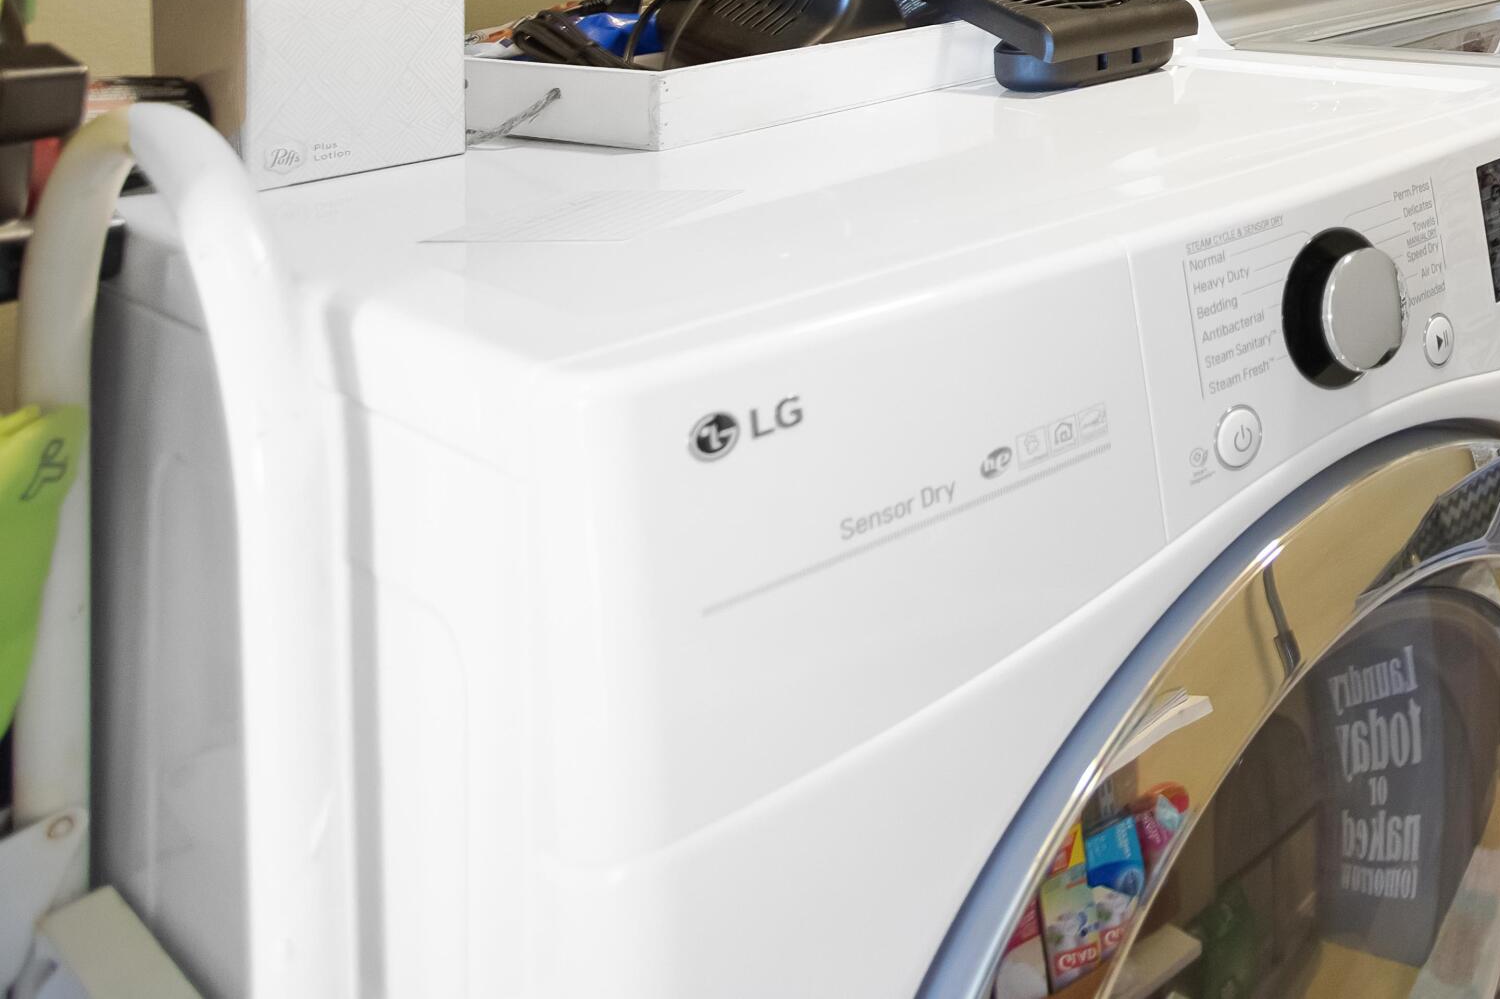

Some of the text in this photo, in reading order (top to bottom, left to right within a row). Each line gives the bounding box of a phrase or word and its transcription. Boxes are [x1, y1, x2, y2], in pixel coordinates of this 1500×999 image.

[313, 150, 351, 162] Lotion
[314, 142, 338, 151] Plus
[270, 148, 301, 169] Puffs
[1403, 200, 1433, 218] Delicates
[1412, 217, 1436, 233] Towels
[1189, 250, 1226, 272] Normal
[1407, 241, 1440, 263] Speed Dry
[1431, 262, 1442, 275] Dry
[1193, 266, 1250, 295] Heavy Duty
[1196, 296, 1239, 320] Bedding
[1202, 307, 1265, 344] Antibacterial
[1204, 348, 1235, 369] Steam
[1208, 373, 1241, 395] Steam
[749, 395, 804, 440] LG
[839, 480, 957, 541] Sensor Dry
